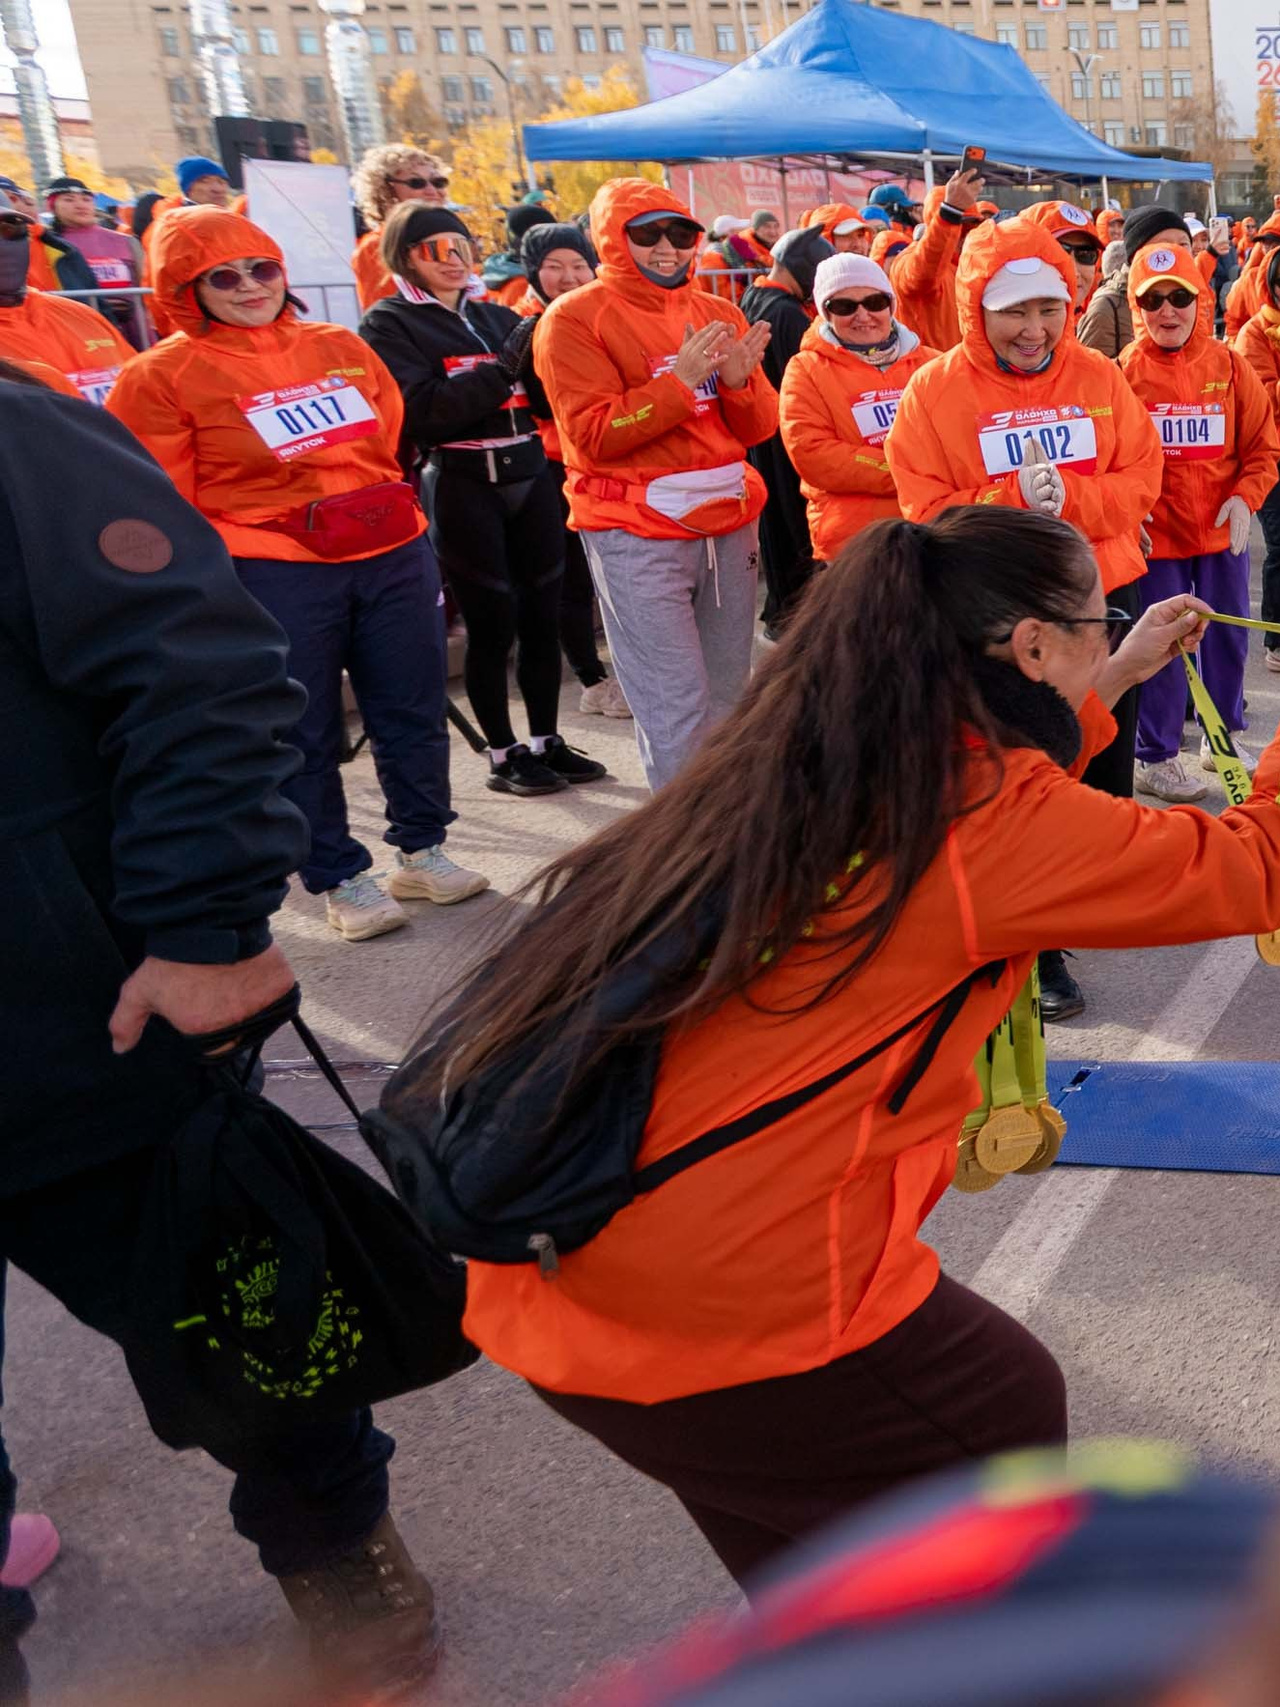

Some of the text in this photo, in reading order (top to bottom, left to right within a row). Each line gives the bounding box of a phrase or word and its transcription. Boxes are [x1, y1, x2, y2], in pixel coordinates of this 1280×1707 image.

[276, 395, 346, 435] 0117
[1162, 418, 1209, 443] 0104
[1223, 769, 1245, 805] ОЛО
